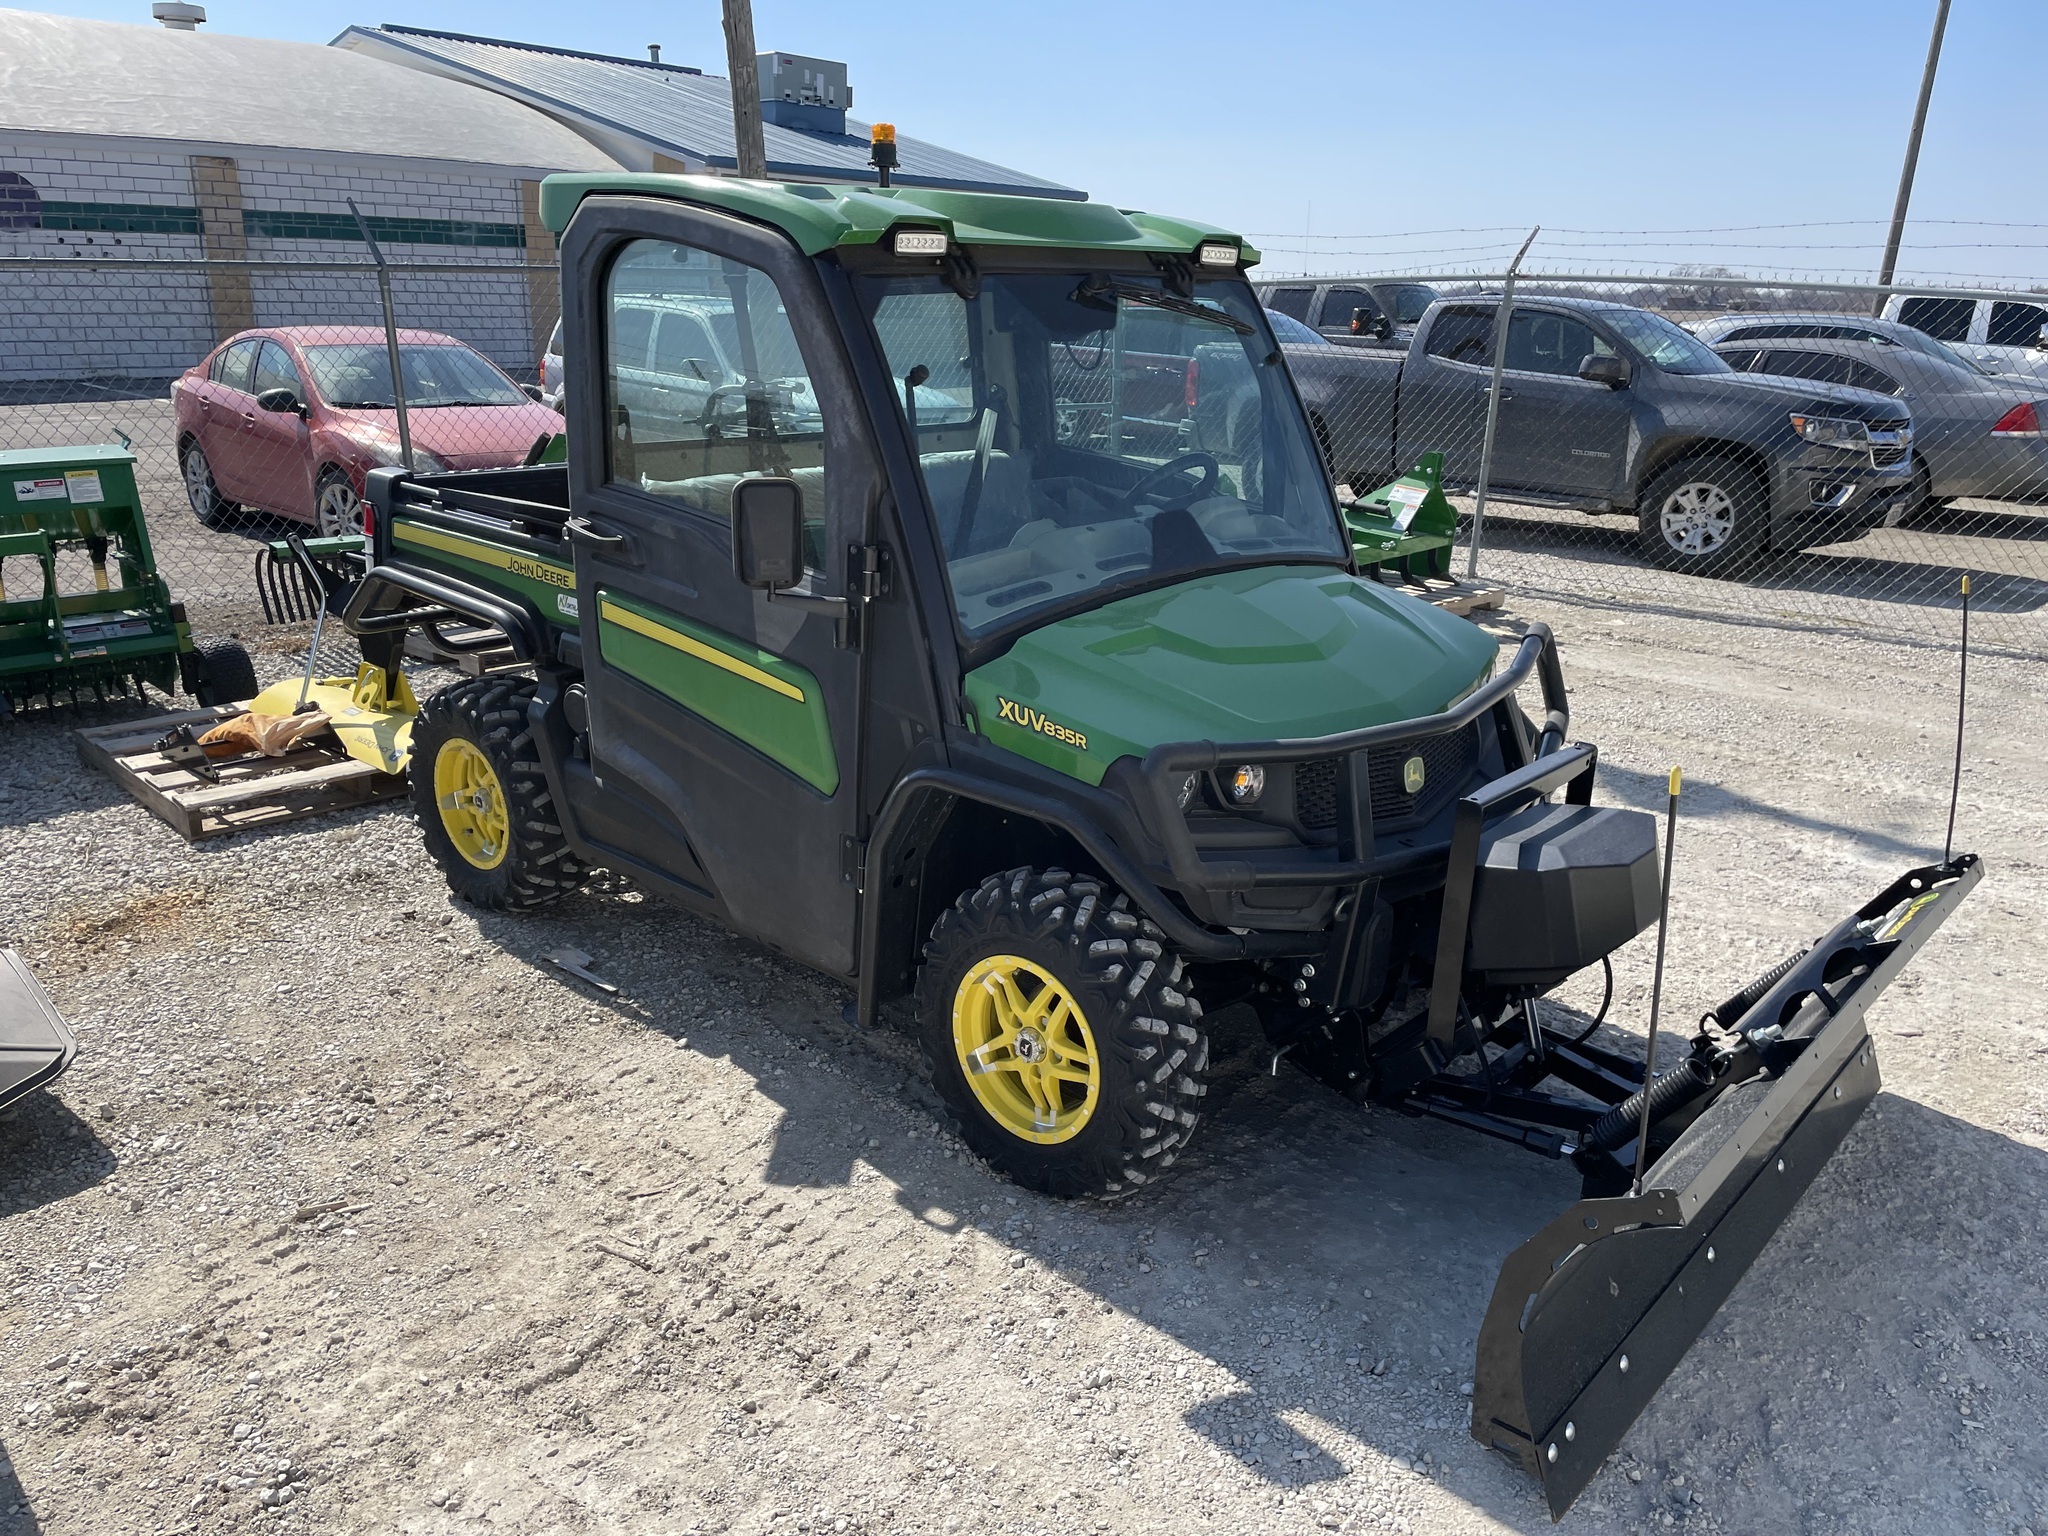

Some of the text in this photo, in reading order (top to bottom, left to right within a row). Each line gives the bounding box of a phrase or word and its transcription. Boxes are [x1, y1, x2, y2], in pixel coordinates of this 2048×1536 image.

[506, 557, 570, 587] JOHN DEERE
[996, 695, 1088, 751] XUV835R
